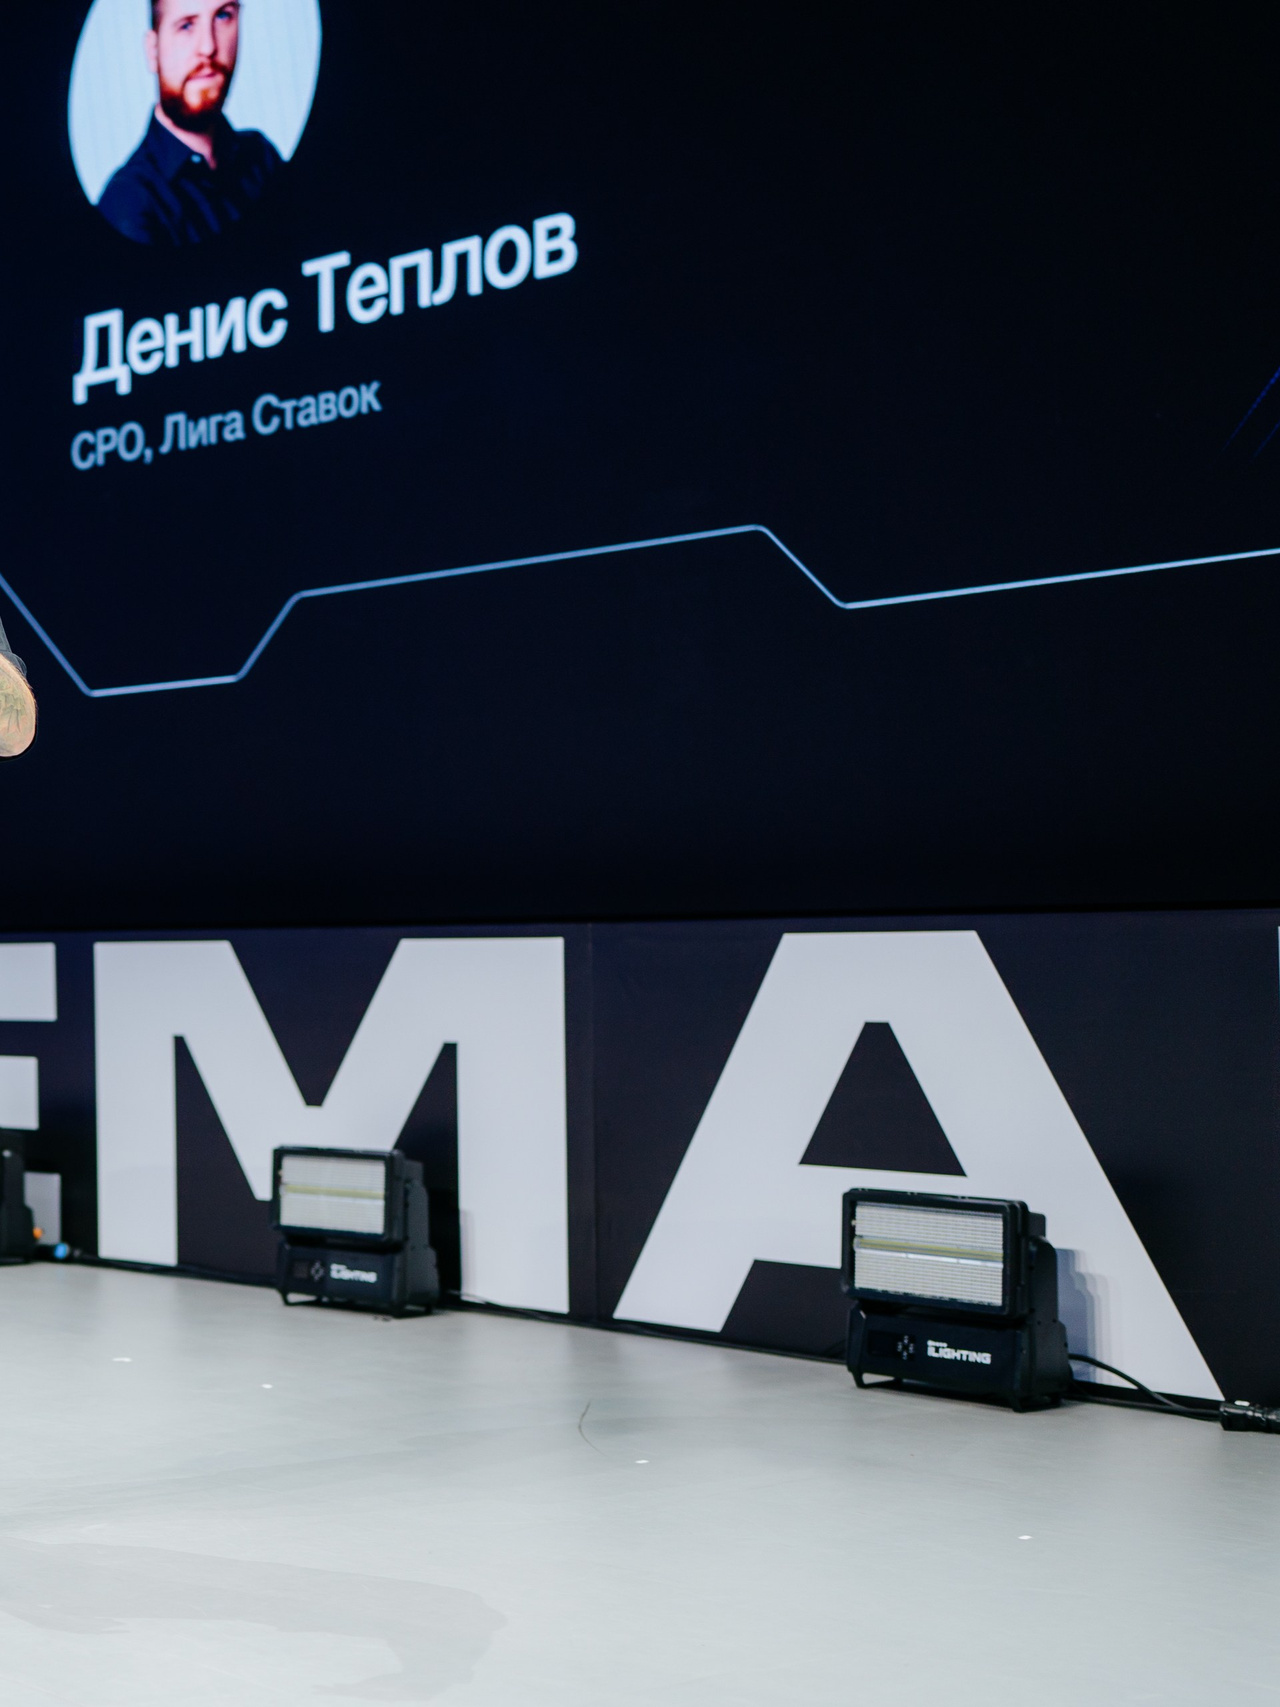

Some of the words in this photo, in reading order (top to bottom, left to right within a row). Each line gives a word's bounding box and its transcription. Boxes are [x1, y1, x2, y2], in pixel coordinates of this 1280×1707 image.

[72, 288, 288, 404] Денис
[301, 212, 579, 332] Теплов
[160, 410, 246, 454] Лига
[252, 380, 382, 436] Ставок
